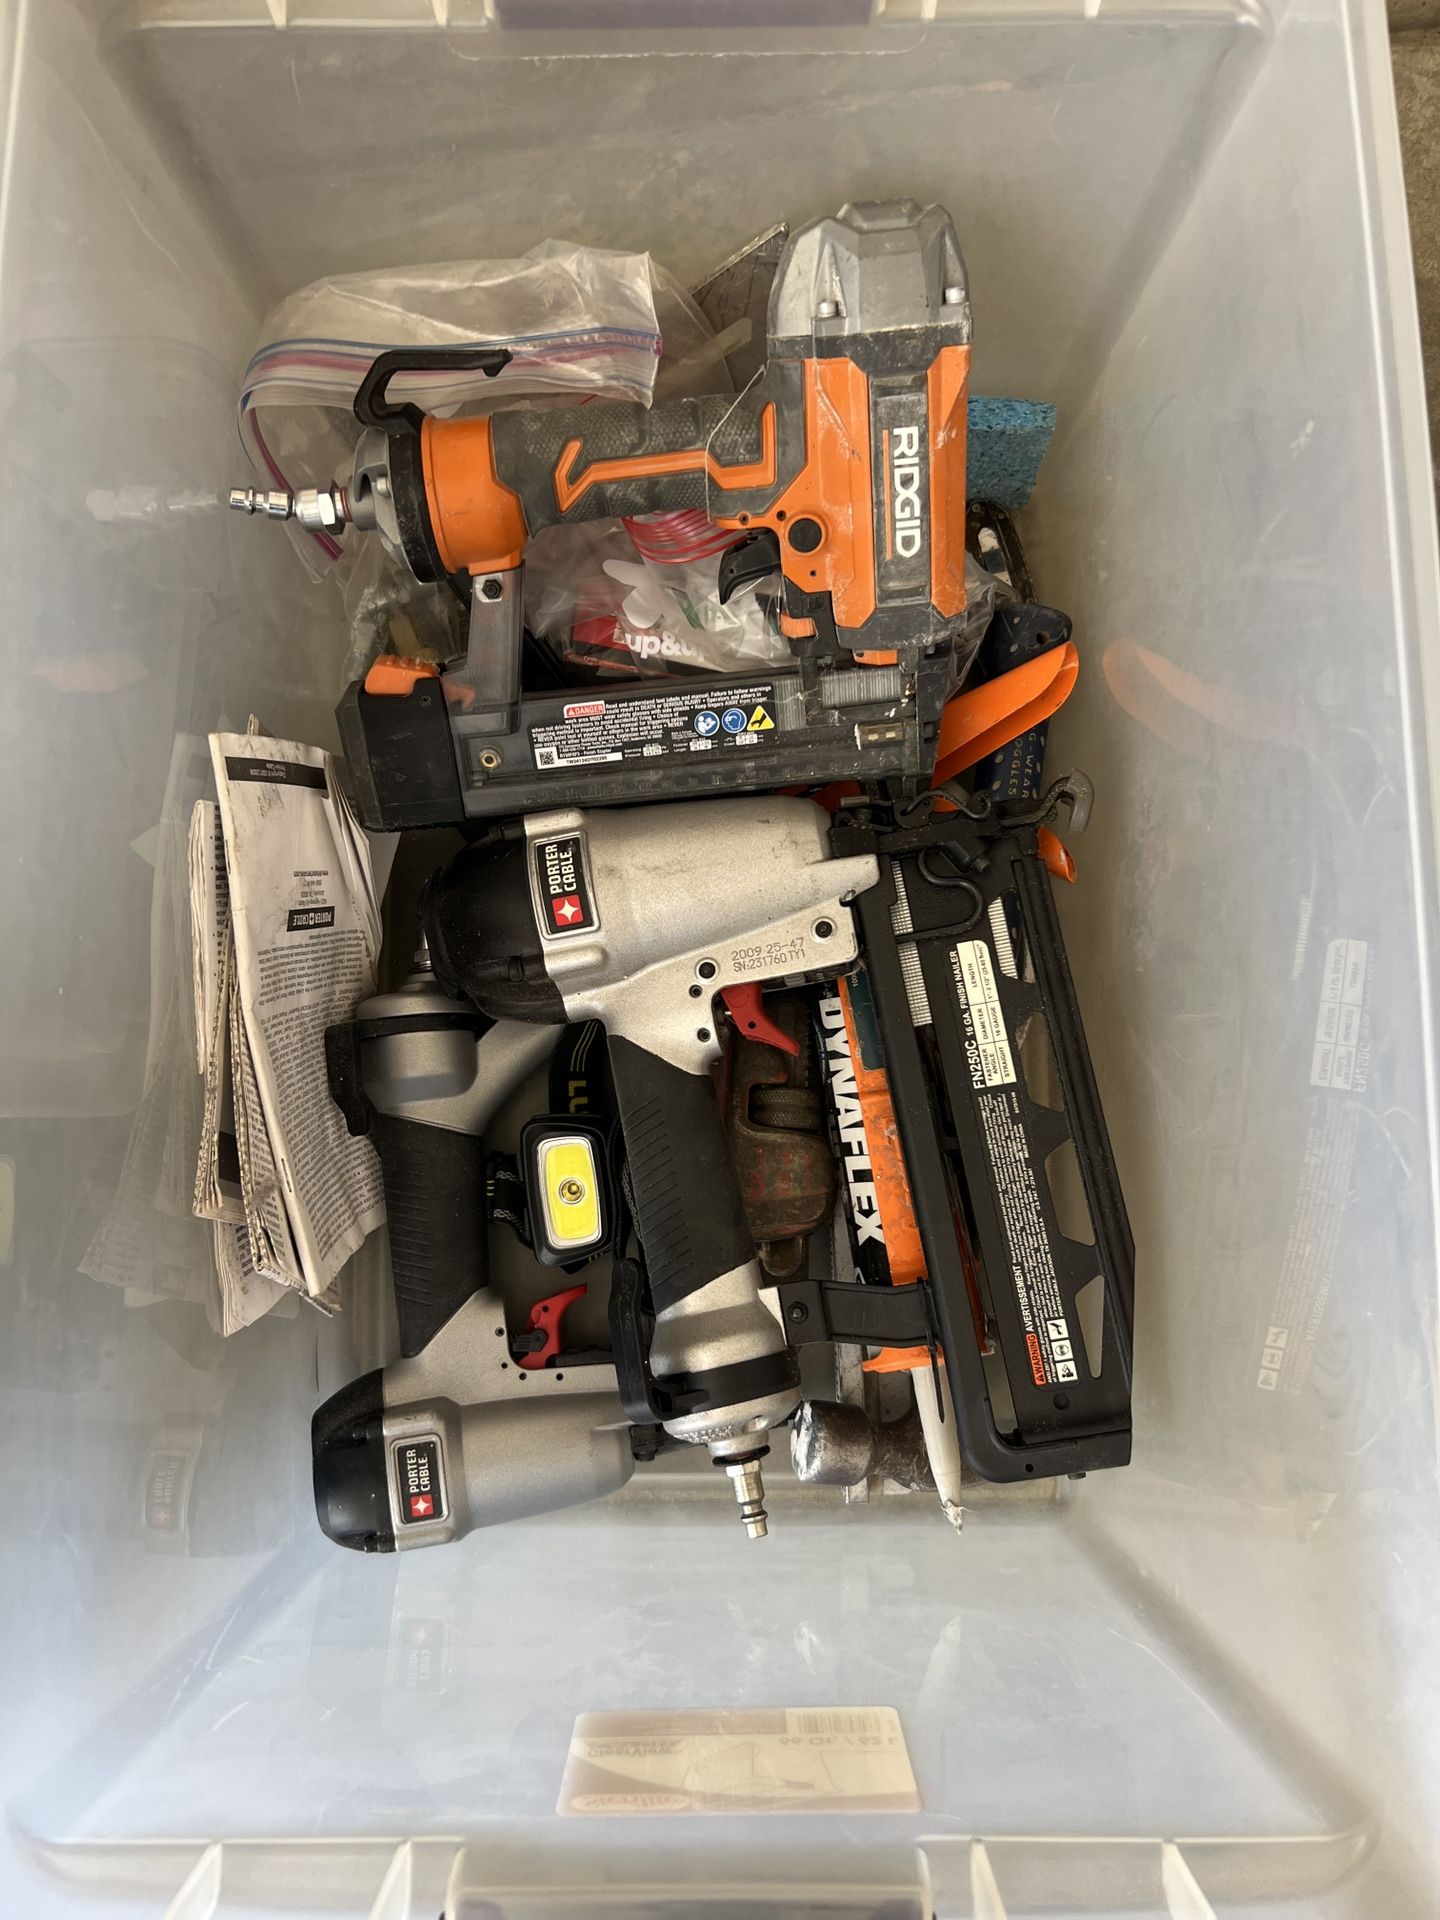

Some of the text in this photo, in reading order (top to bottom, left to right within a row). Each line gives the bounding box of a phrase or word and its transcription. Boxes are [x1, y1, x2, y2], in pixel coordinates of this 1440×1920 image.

[893, 426, 921, 558] RIDGID
[624, 630, 704, 661] up&u
[575, 704, 604, 716] DANGER
[1007, 738, 1023, 796] OGGLES
[545, 844, 563, 895] PORTER
[560, 850, 577, 892] CABLE
[731, 937, 804, 961] 2009 25-47
[733, 952, 787, 972] SN:231760
[968, 963, 977, 987] LENGTH
[949, 951, 986, 1090] FN250C 16 GA. FINISH NAILER
[978, 1008, 988, 1039] DIAMETER
[990, 1006, 999, 1028] GAUGE
[982, 1048, 993, 1081] FASTENER
[989, 1053, 998, 1074] ANGLE
[998, 1046, 1010, 1077] STRAIGHT
[819, 997, 886, 1247] DYNAFLEX
[1014, 1264, 1034, 1332] AVERTISSEMENT
[1029, 1334, 1043, 1374] WARNING
[406, 1449, 420, 1493] PORTER
[418, 1456, 431, 1492] CABLE
